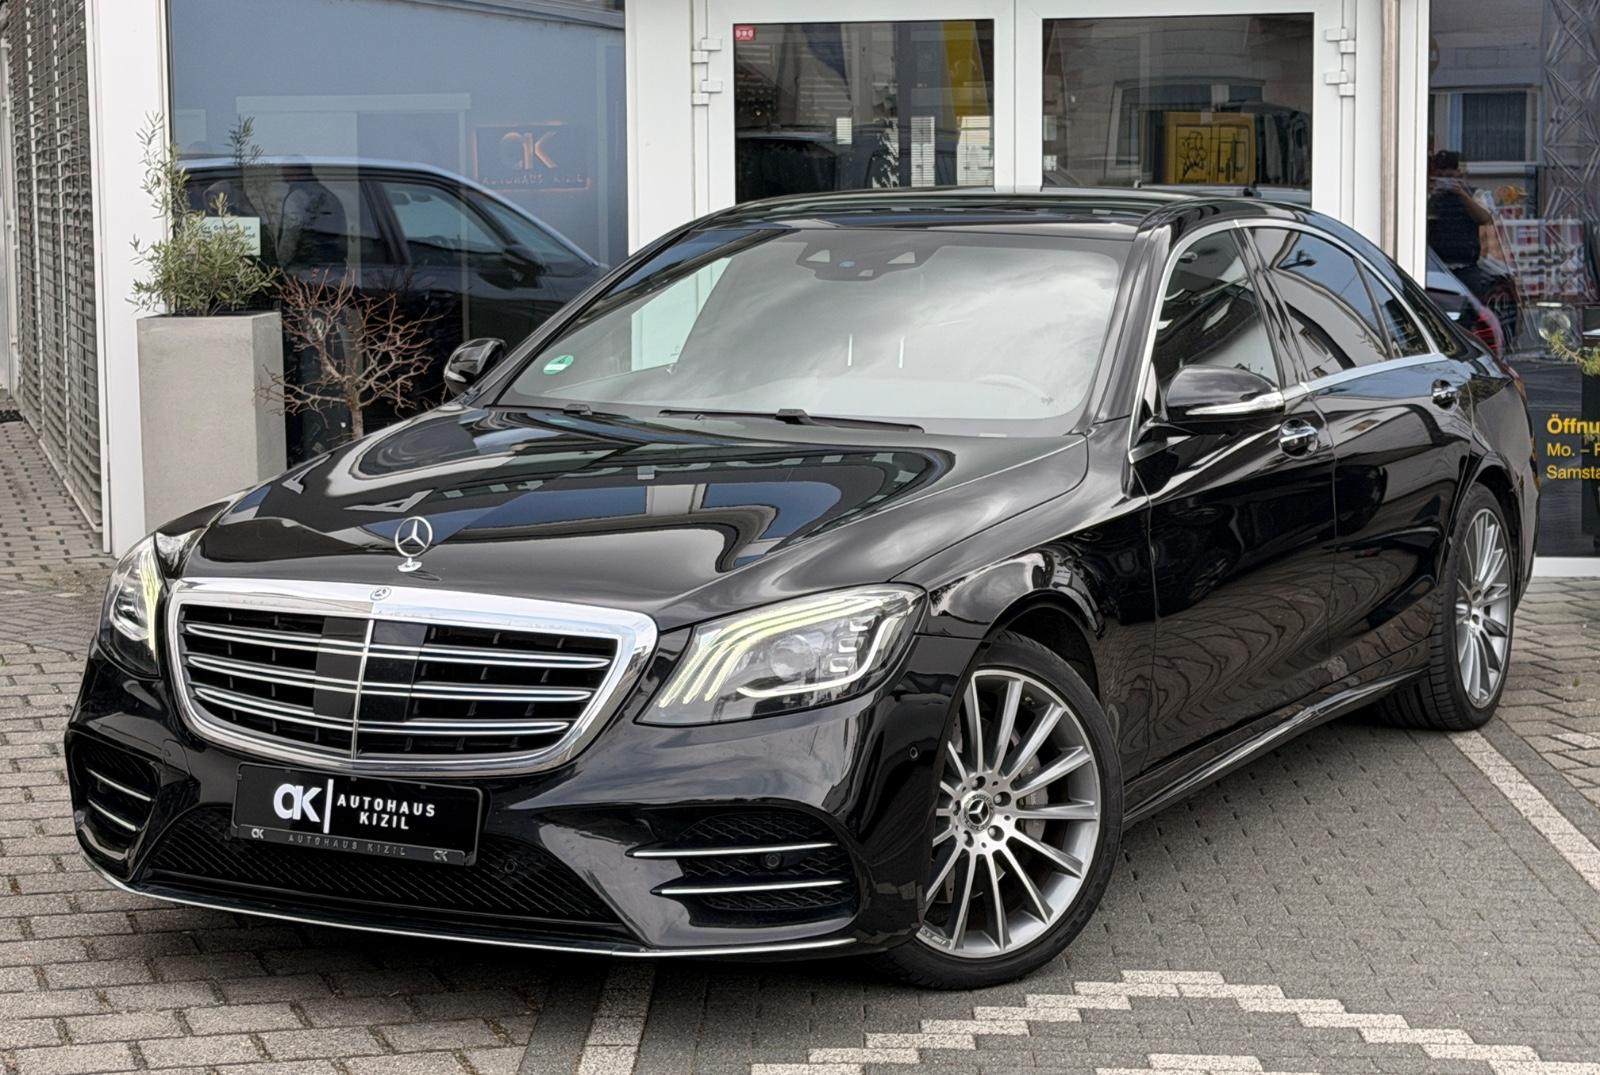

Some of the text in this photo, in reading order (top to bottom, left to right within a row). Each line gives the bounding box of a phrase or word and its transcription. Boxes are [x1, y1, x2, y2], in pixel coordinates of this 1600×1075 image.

[1546, 413, 1600, 434] Öffnu
[1547, 443, 1575, 457] Mo.
[337, 794, 436, 817] AUTOHAUS
[359, 811, 410, 830] KIZIL
[287, 834, 406, 856] AUTOHAUS KIZIL
